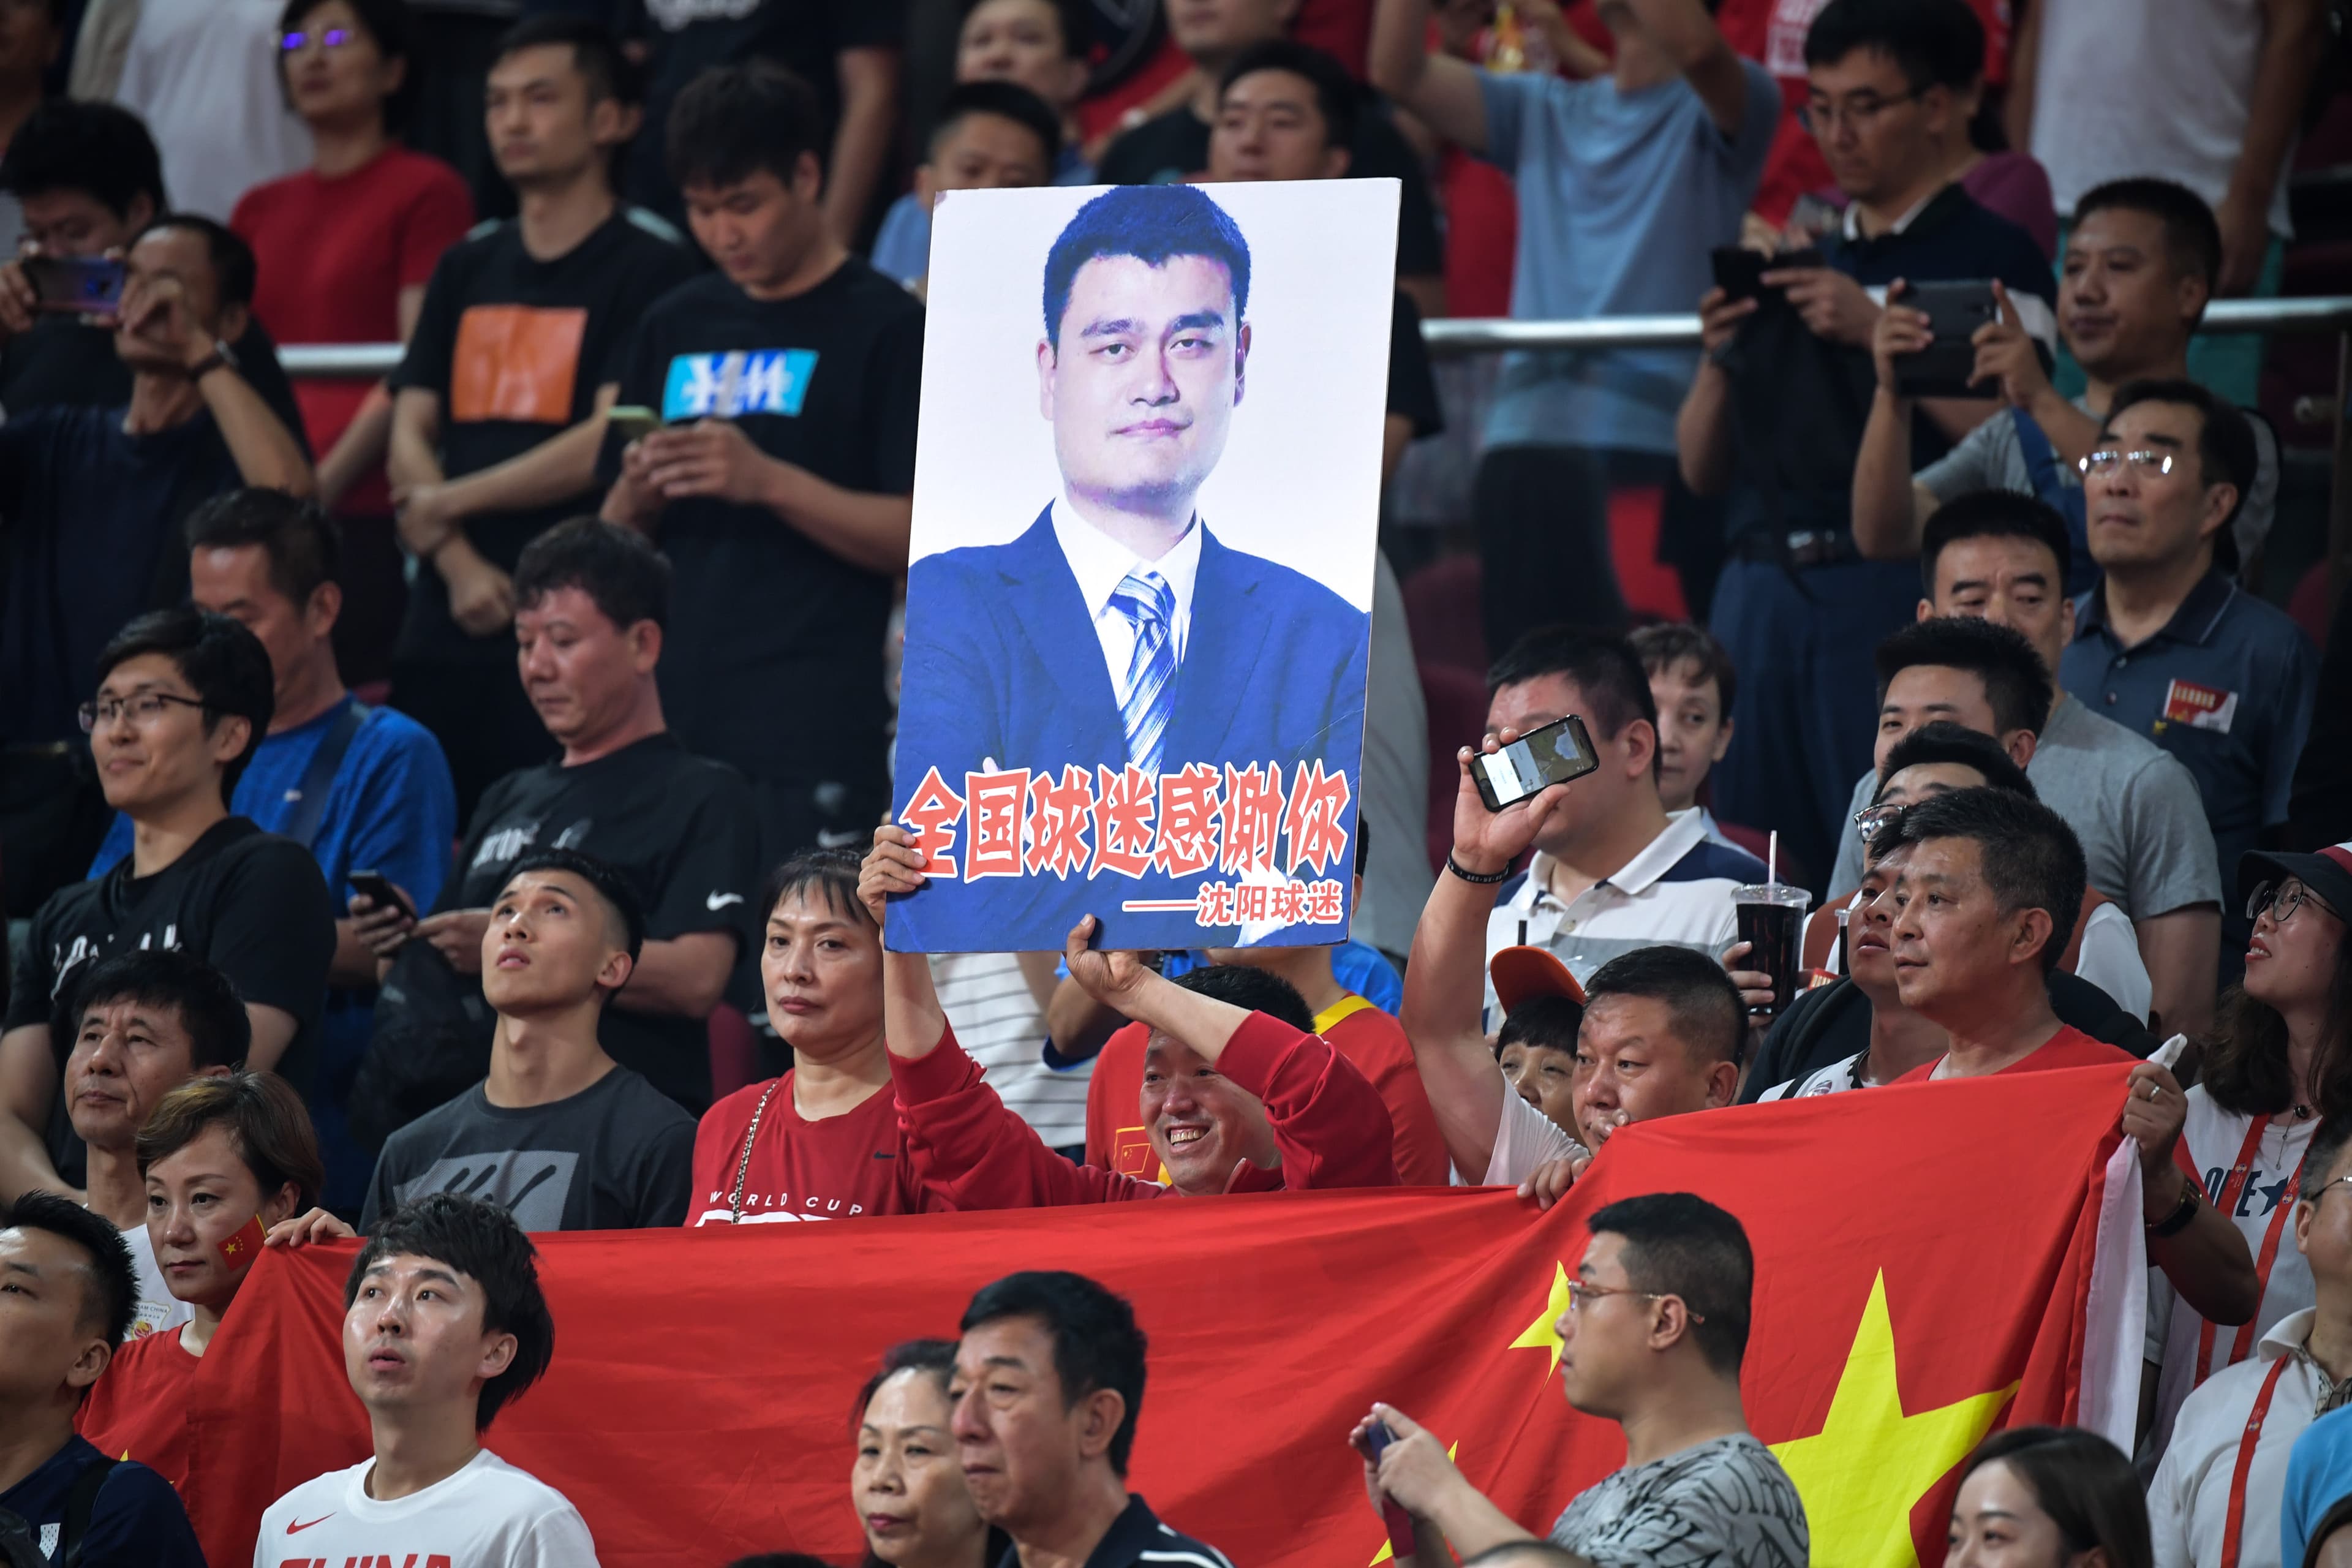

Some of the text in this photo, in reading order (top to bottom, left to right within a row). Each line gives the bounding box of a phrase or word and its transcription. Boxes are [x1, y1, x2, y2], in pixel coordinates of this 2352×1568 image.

[898, 758, 1351, 883] 全国球迷感谢你
[709, 1191, 863, 1215] WORLD CUP
